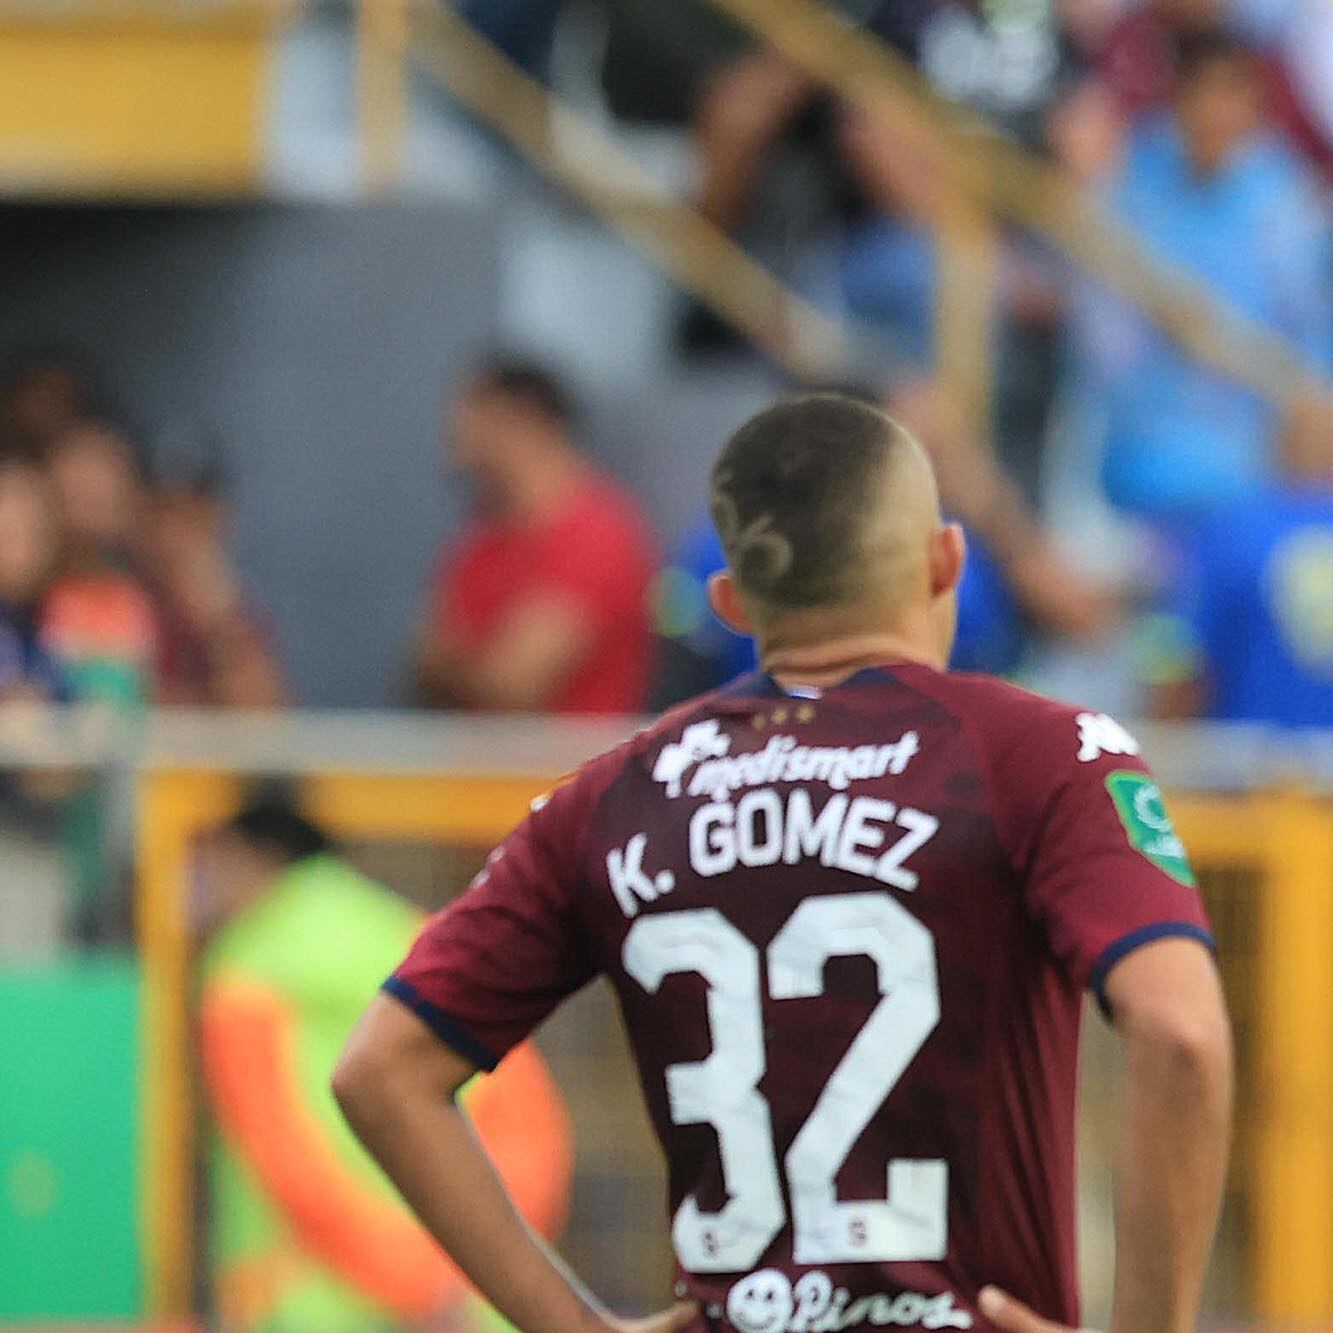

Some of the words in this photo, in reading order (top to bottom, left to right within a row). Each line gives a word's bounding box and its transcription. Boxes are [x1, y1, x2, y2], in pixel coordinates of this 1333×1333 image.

[606, 832, 676, 919] K.
[689, 788, 940, 892] GOMEZ
[621, 891, 949, 1273] 32
